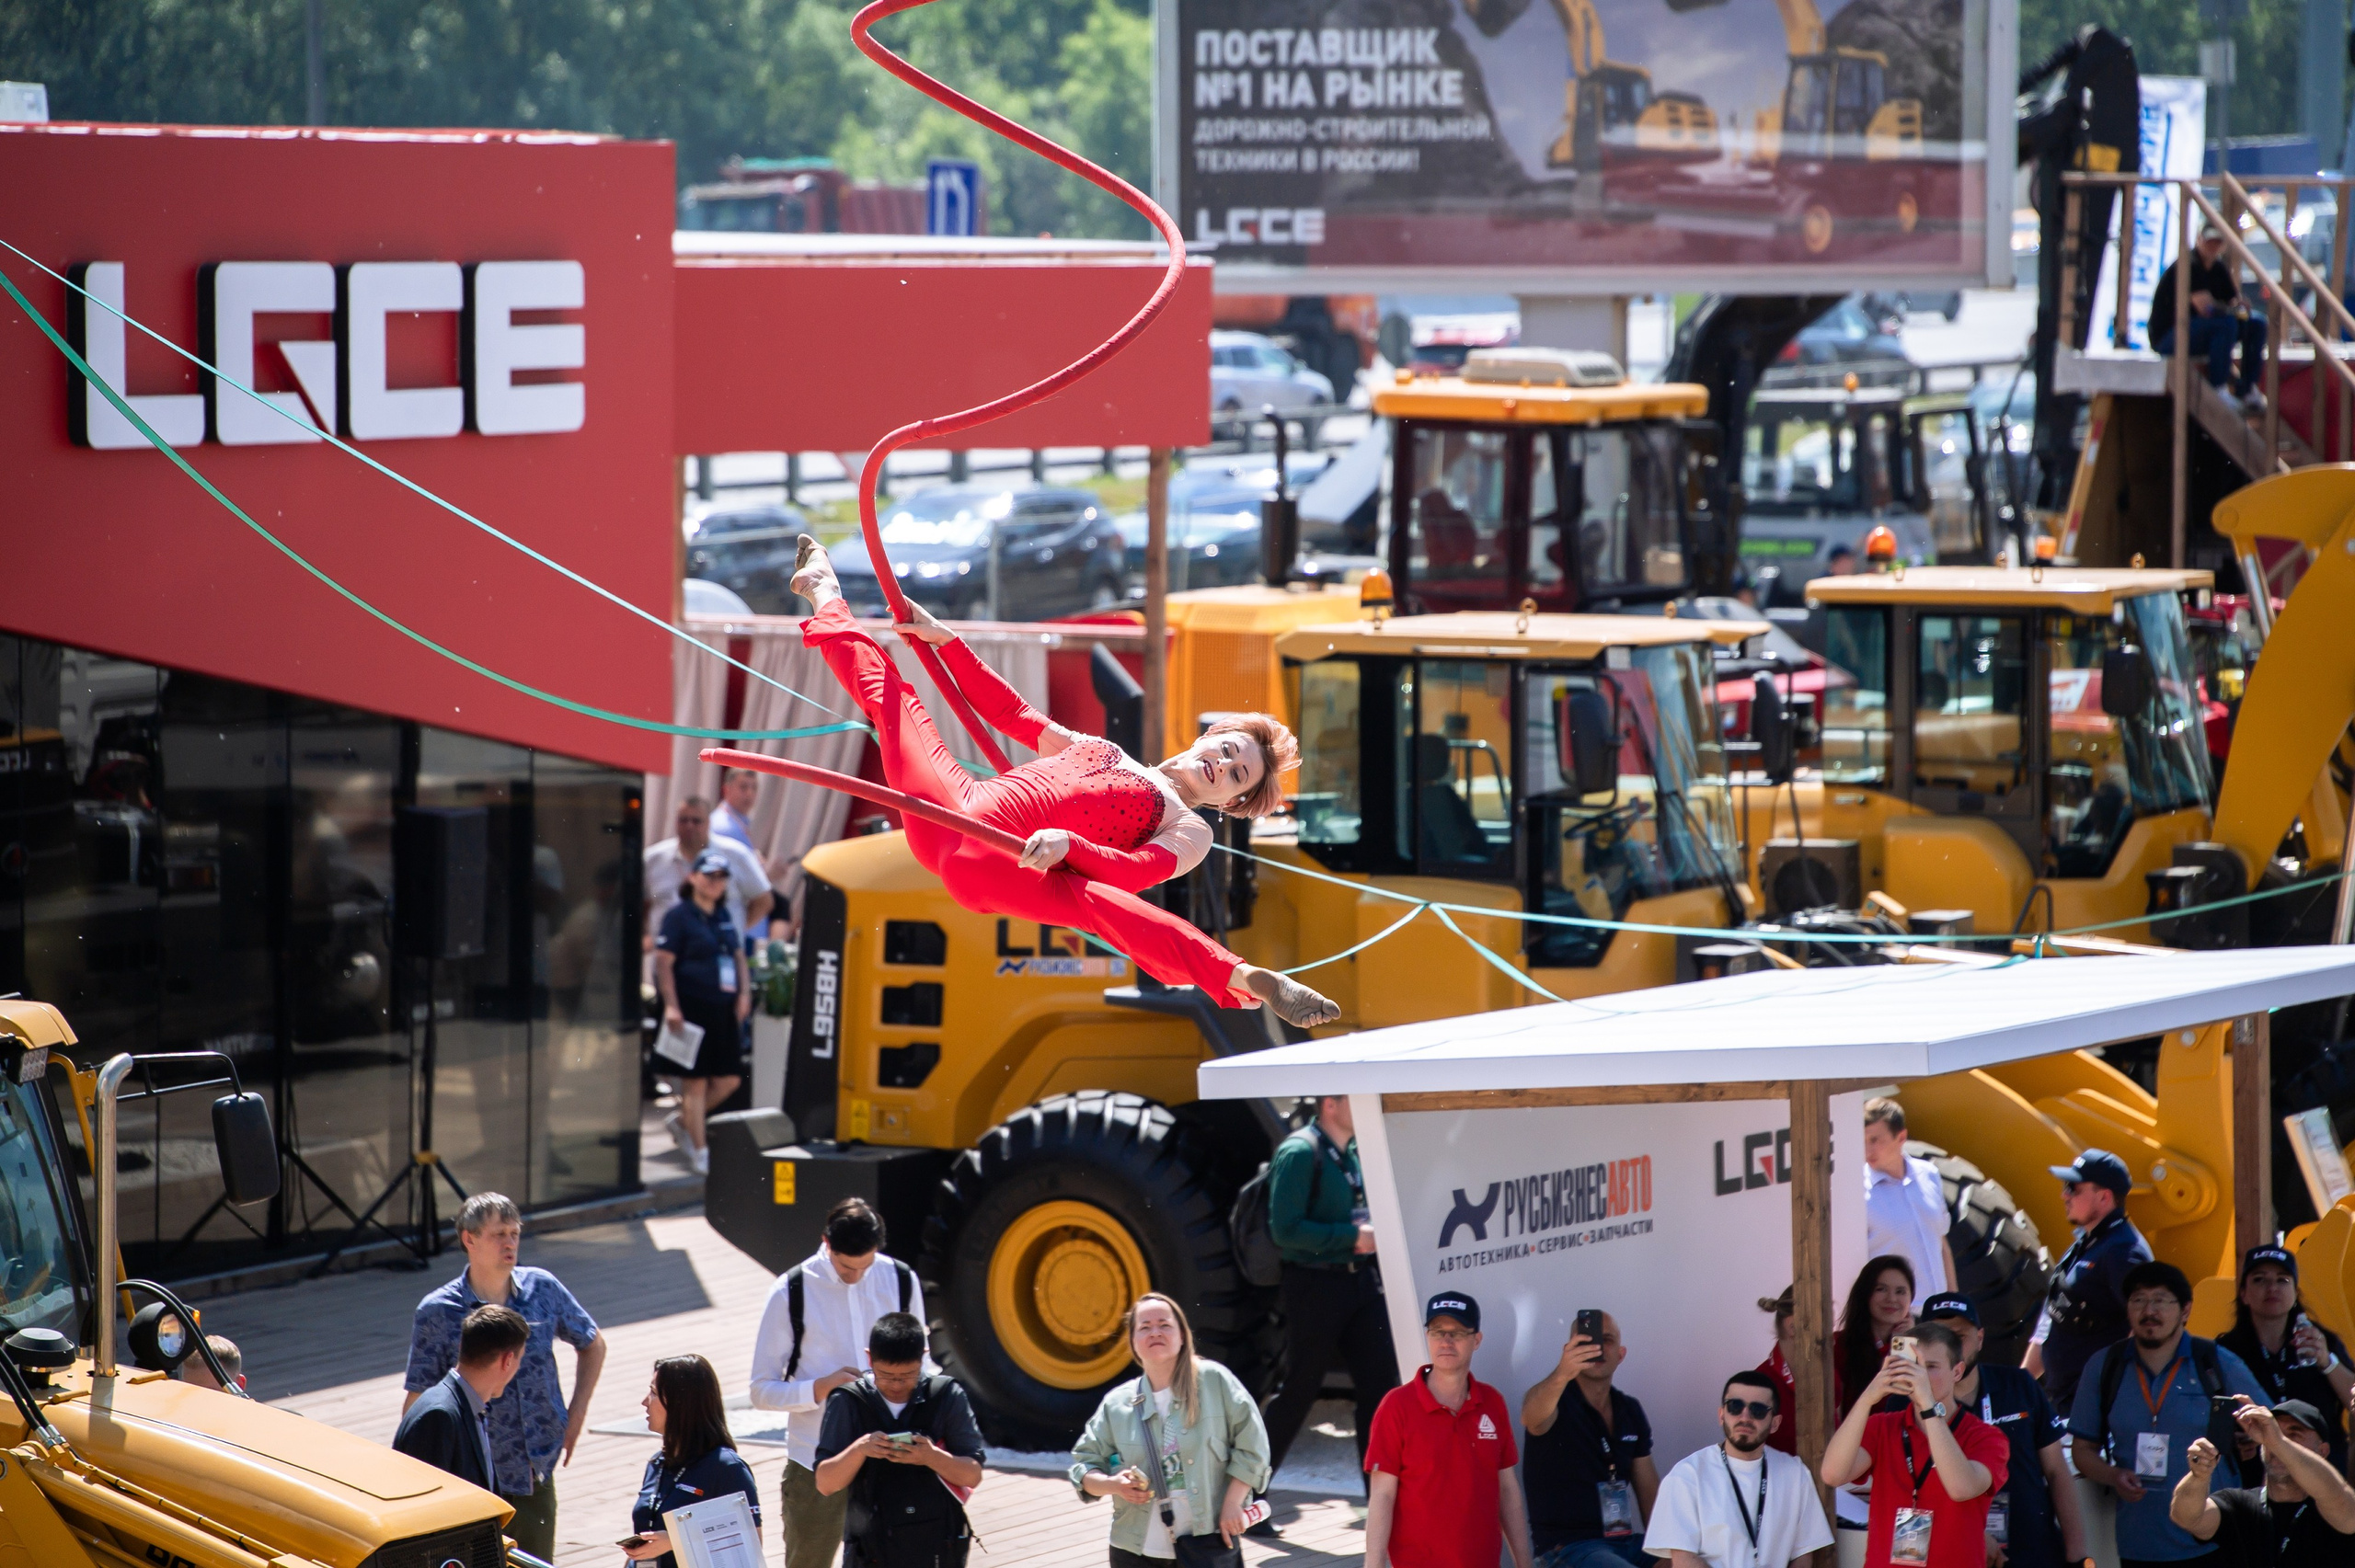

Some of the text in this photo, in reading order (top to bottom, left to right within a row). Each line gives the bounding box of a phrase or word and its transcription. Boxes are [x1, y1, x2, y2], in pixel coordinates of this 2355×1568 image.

[1196, 29, 1441, 67] ПОСТАВЩИК
[1195, 70, 1465, 108] №1 НА РЫНКЕ
[1194, 117, 1490, 143] ДОРОЖНО-СТРОИТЕЛЬНОЙ
[1195, 148, 1298, 173] ТЕХНИКИ
[1302, 149, 1317, 172] В
[70, 260, 586, 450] LGCE
[811, 948, 839, 1059] L958H
[1503, 1154, 1652, 1238] РУСБИЗНЕСАВТО
